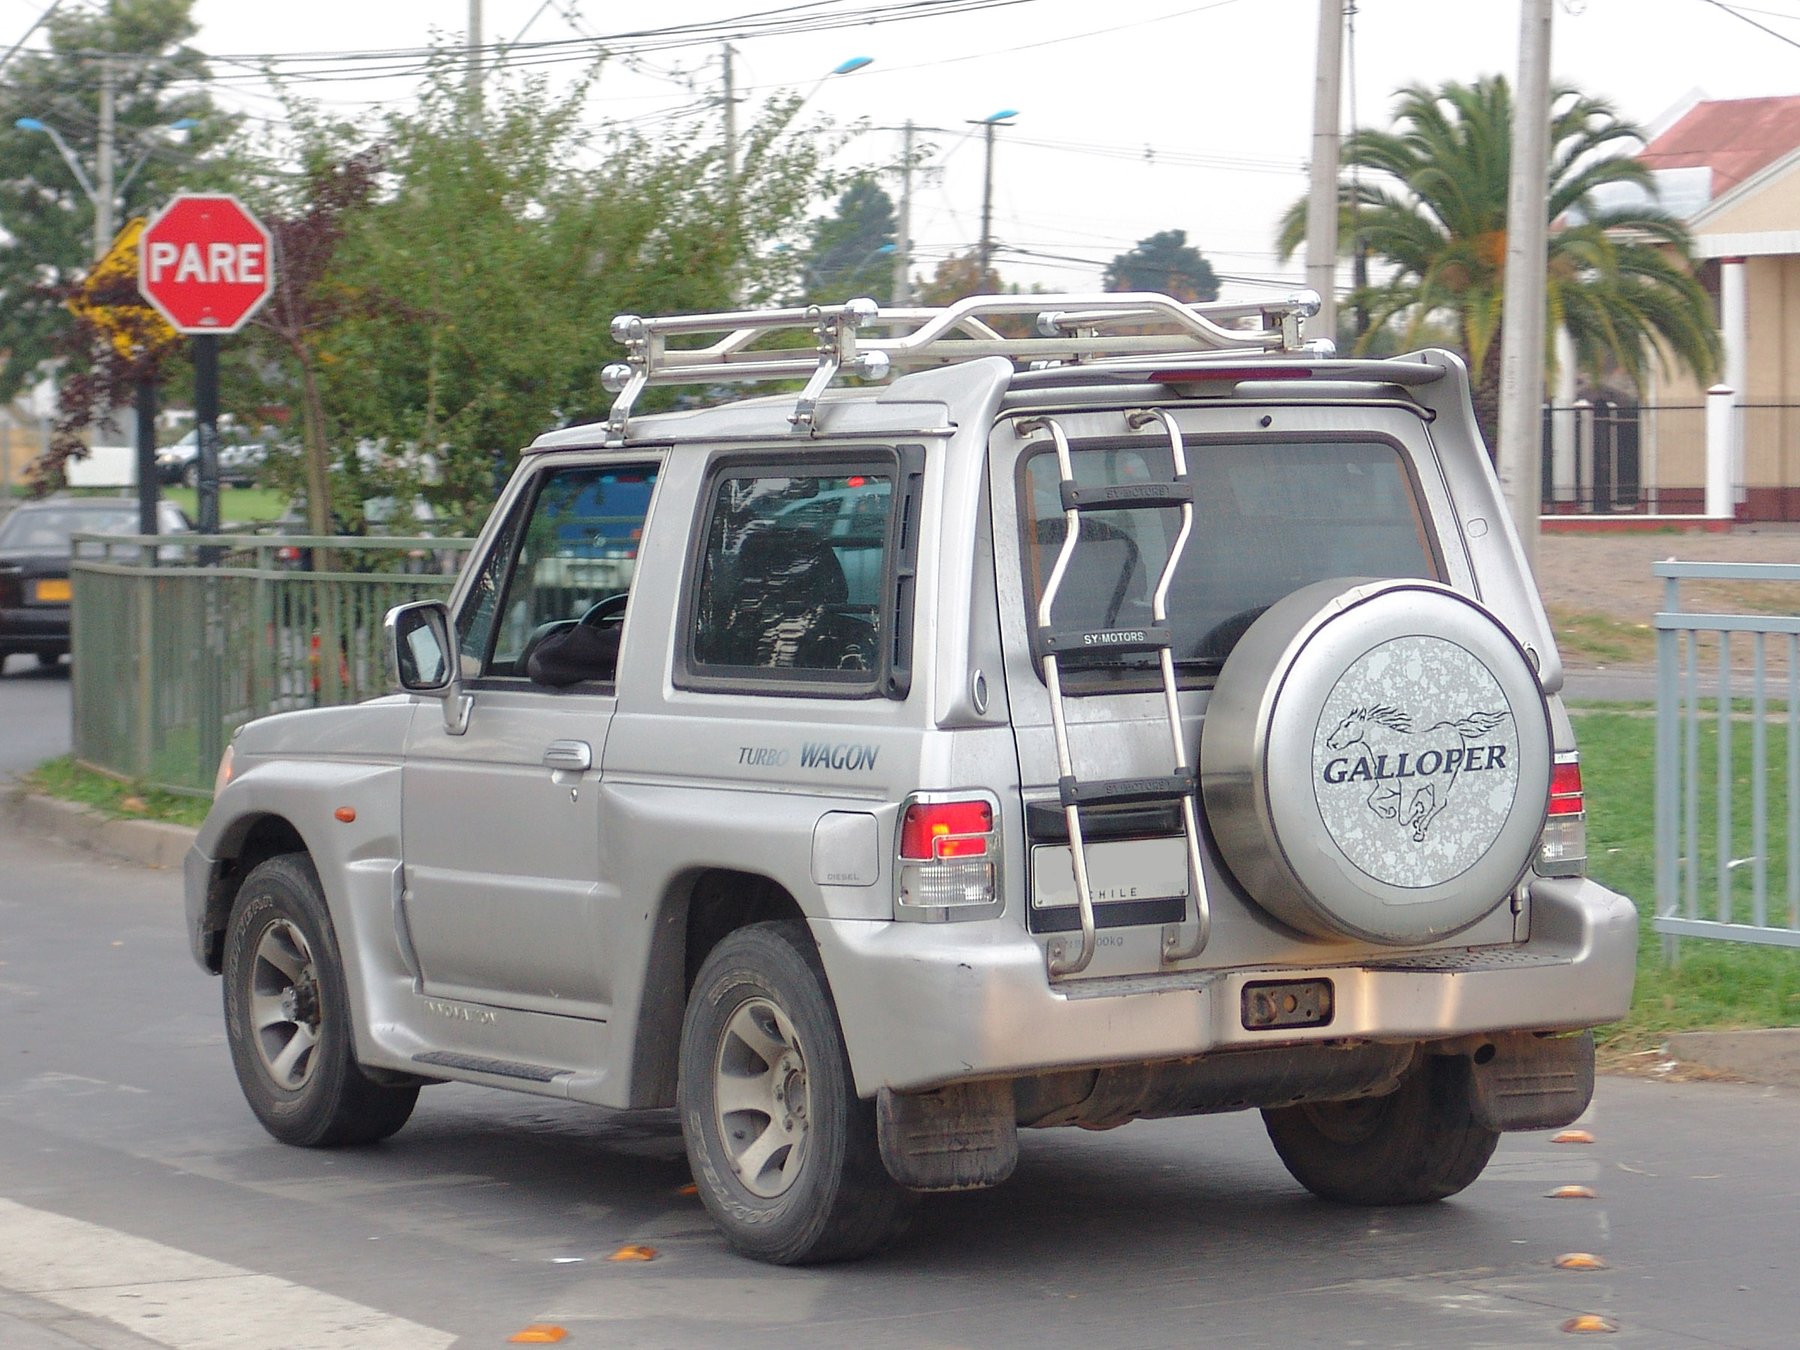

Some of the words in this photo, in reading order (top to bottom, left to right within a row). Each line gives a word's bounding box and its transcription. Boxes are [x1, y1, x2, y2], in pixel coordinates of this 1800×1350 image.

[149, 242, 264, 283] PARE
[738, 747, 790, 766] TURBO
[800, 743, 880, 771] WAGON
[1323, 745, 1507, 784] GALLOPER
[827, 873, 860, 881] DIESEL
